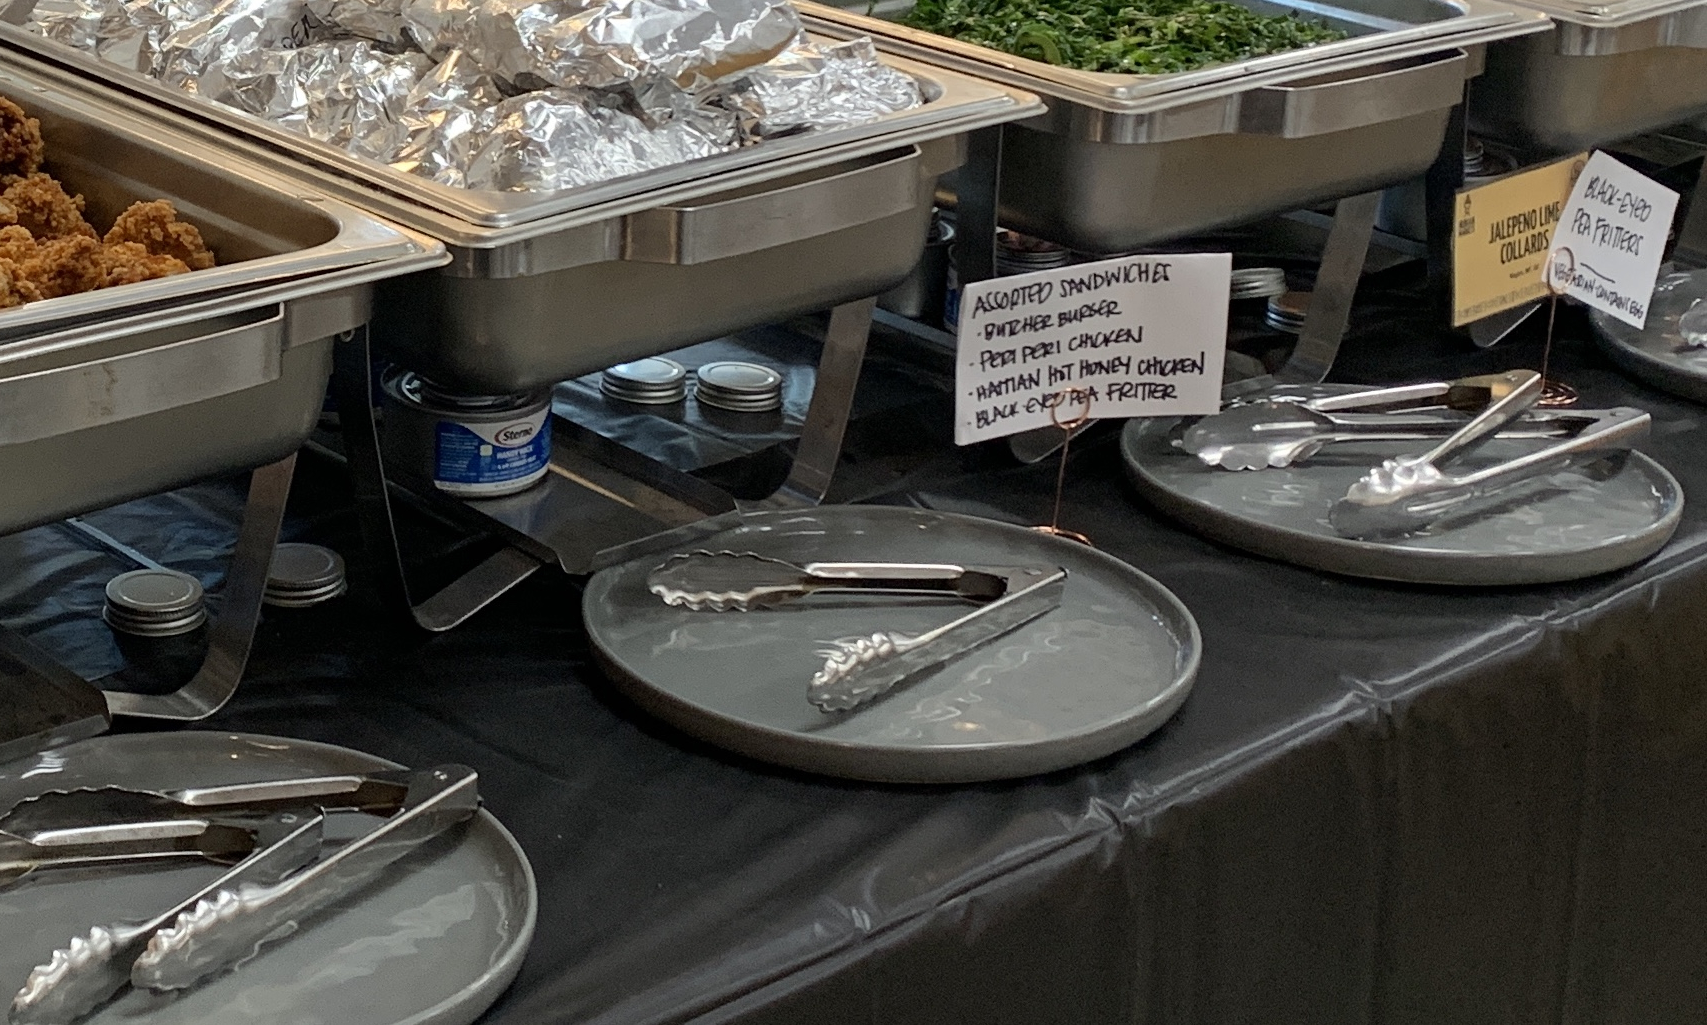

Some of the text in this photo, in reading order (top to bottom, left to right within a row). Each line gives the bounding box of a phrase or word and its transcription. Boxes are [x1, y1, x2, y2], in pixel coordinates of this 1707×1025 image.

[1488, 209, 1538, 244] JALEPENO
[1540, 201, 1560, 226] LIME
[1571, 207, 1644, 256] PEA FRITTERS
[1500, 229, 1550, 264] COLLARDS
[972, 262, 1172, 319] ASSORTED SANDWICHES
[984, 298, 1123, 341] BUTCHER BURGER
[979, 326, 1143, 373] PERI PERI CHICKEN
[976, 350, 1206, 402] HAITIAN HOT HONEY CHICKEN
[1106, 382, 1178, 402] FRITTER
[501, 426, 533, 441] Sterno
